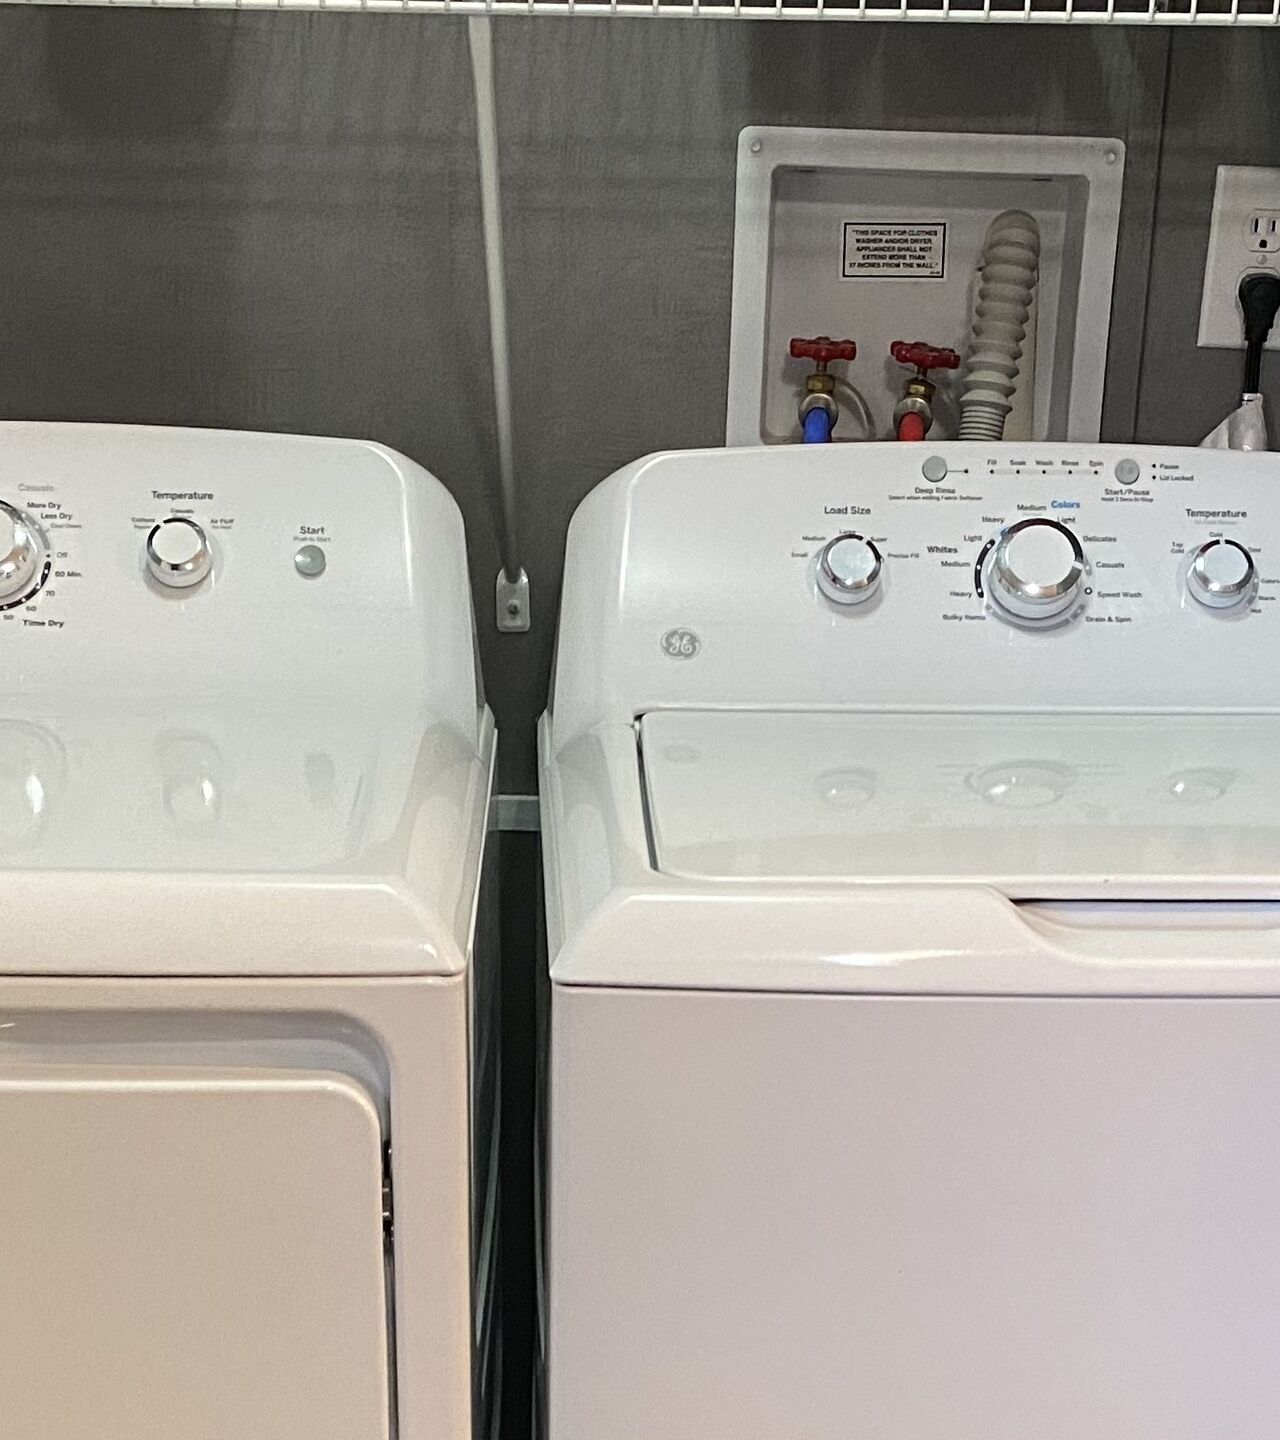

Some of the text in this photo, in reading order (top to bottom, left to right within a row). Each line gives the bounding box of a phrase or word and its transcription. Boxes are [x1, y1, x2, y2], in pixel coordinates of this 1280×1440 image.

[914, 486, 934, 495] Deep
[1104, 488, 1150, 496] Start/Pause
[151, 490, 214, 501] Temperature
[48, 502, 62, 511] Dry
[1051, 501, 1080, 509] Colors
[824, 506, 872, 515] Load Size
[1185, 508, 1248, 519] Temperature
[40, 512, 73, 521] Less Dry
[300, 526, 325, 535] Start
[963, 534, 982, 542] Light
[1082, 535, 1117, 543] Delicates
[927, 545, 959, 554] Whites
[47, 619, 65, 628] Dry
